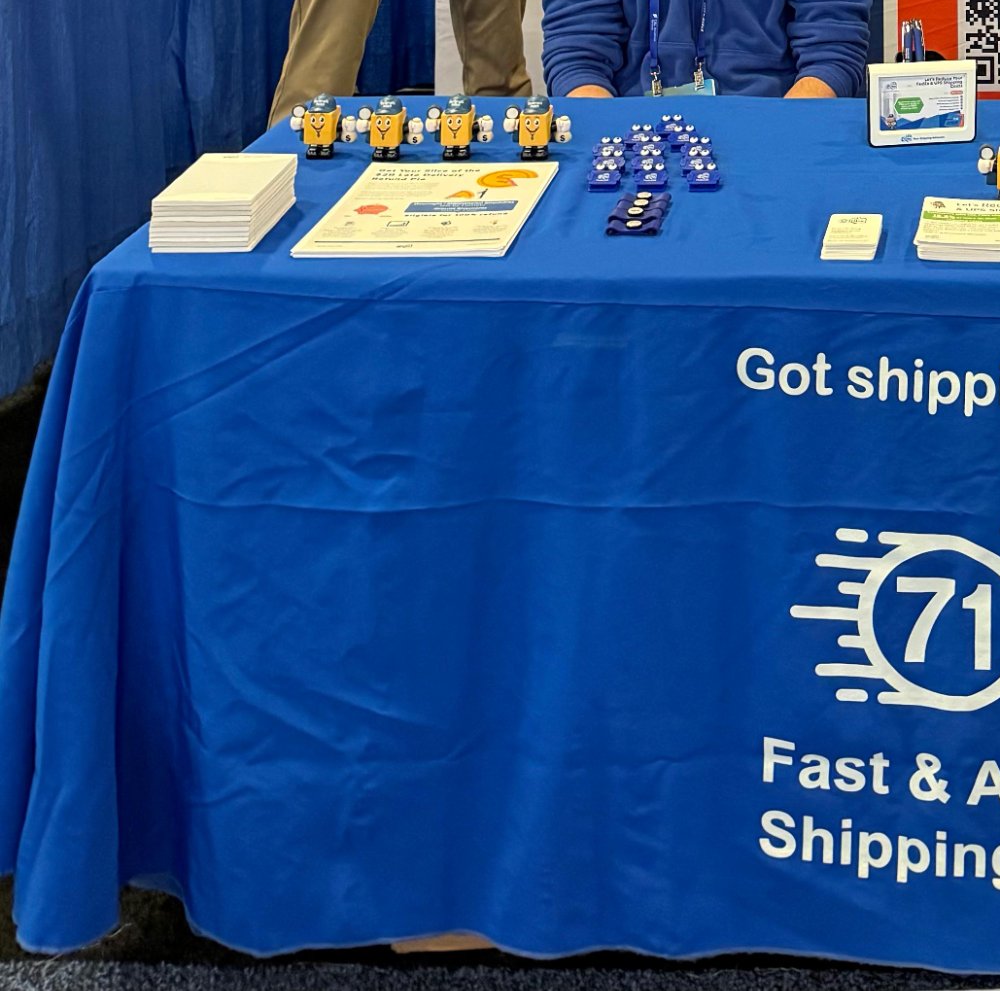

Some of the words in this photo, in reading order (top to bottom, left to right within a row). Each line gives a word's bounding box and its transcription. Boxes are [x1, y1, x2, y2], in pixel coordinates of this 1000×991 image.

[736, 346, 834, 396] Got
[896, 576, 992, 671] 71
[762, 736, 890, 794] Fast
[908, 752, 951, 804] &
